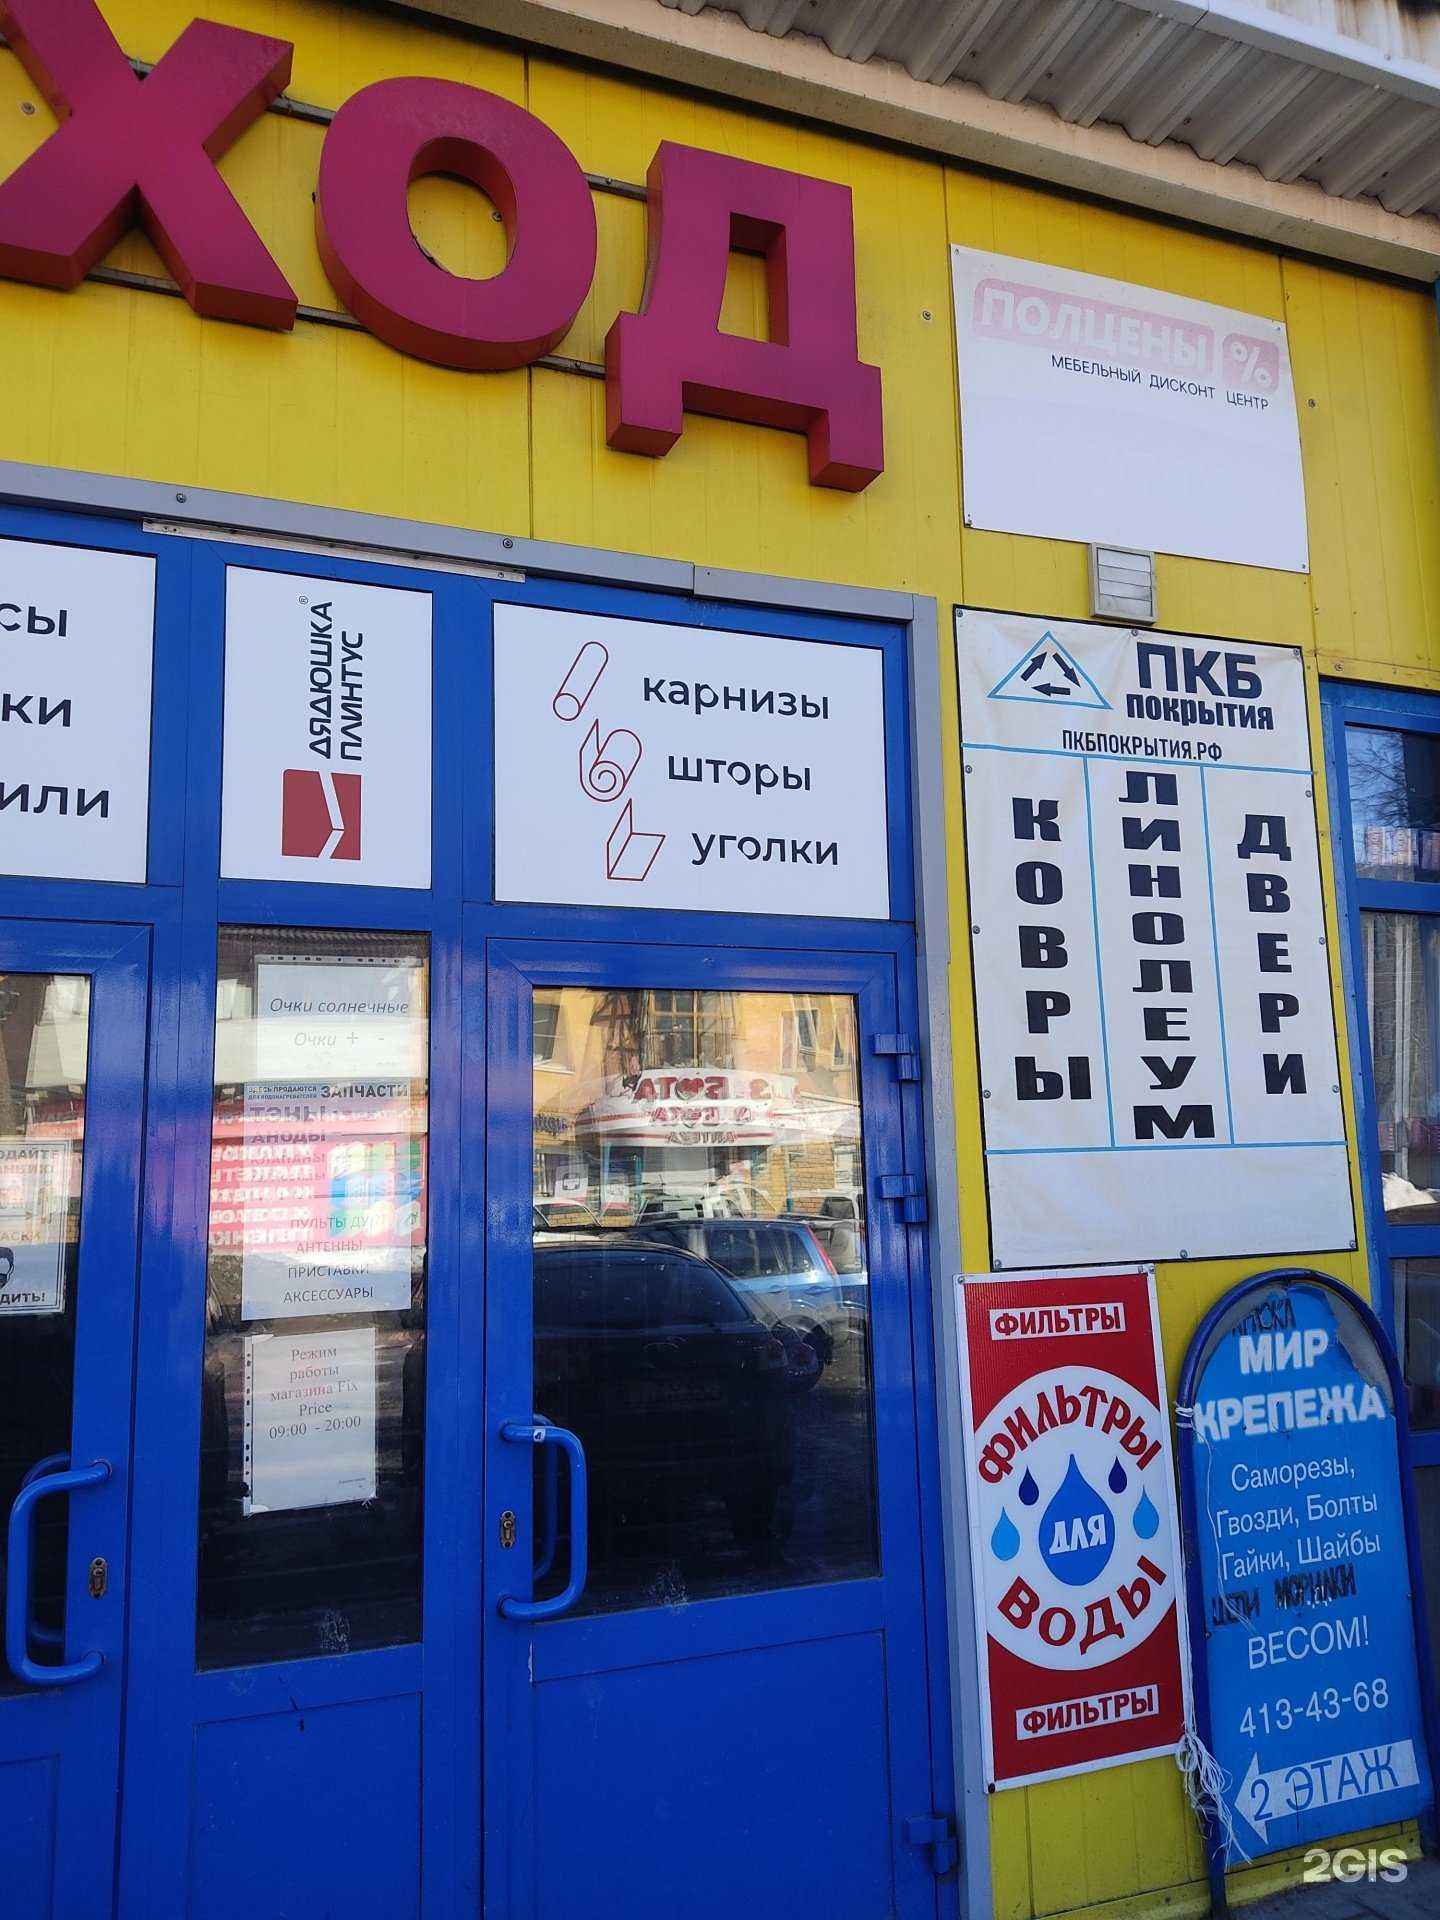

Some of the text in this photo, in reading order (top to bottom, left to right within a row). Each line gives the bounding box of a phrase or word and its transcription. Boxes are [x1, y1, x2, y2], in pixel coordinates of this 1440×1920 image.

[0, 0, 884, 492] ХОД
[1051, 354, 1270, 411] МЕБЕЛЬНЫЙ ДИСКОНТ ЦЕНТР
[308, 601, 333, 759] ДЯДЮШКА
[1136, 641, 1263, 699] ПКБ
[340, 631, 364, 761] ПЛИНТУС
[643, 677, 829, 720] карнизы
[1062, 729, 1223, 761] ПКБПОКРЫТИЯ.РФ
[668, 755, 811, 795] шторы
[691, 832, 838, 865] уголки
[1011, 797, 1092, 1101] КОВРЫ
[1118, 770, 1216, 1140] ЛИНОЛЕУМ
[1236, 814, 1307, 1095] ДВЕРИ
[270, 998, 409, 1014] Очки солнечные
[321, 1084, 408, 1099] ЗАПЧАСТИ
[283, 1287, 374, 1304] АКСЕССУАРЫ
[994, 1305, 1121, 1336] ФИЛЬТРЫ
[290, 1365, 339, 1383] работы
[291, 1347, 337, 1362] Режим
[1239, 1328, 1329, 1375] МИР
[271, 1385, 333, 1402] магазина
[299, 1403, 332, 1417] Price
[1194, 1384, 1386, 1443] КРЕПЕЖА
[269, 1422, 307, 1440] 09:00
[325, 1415, 361, 1433] 20:00
[978, 1384, 1162, 1484] ФИЛЬТРЫ
[1231, 1455, 1355, 1492] Саморезы,
[1049, 1514, 1107, 1555] ДЛЯ
[1217, 1493, 1378, 1538] Гвозди, Болты
[1222, 1529, 1381, 1580] Гайки, Шайбы
[997, 1555, 1167, 1655] ВОДЫ
[1248, 1615, 1369, 1671] ВЕСОМ!
[1023, 1687, 1153, 1733] ФИЛЬТРЫ
[1239, 1678, 1389, 1738] 413-43-68
[1251, 1746, 1399, 1821] 2 ЭТАЖ
